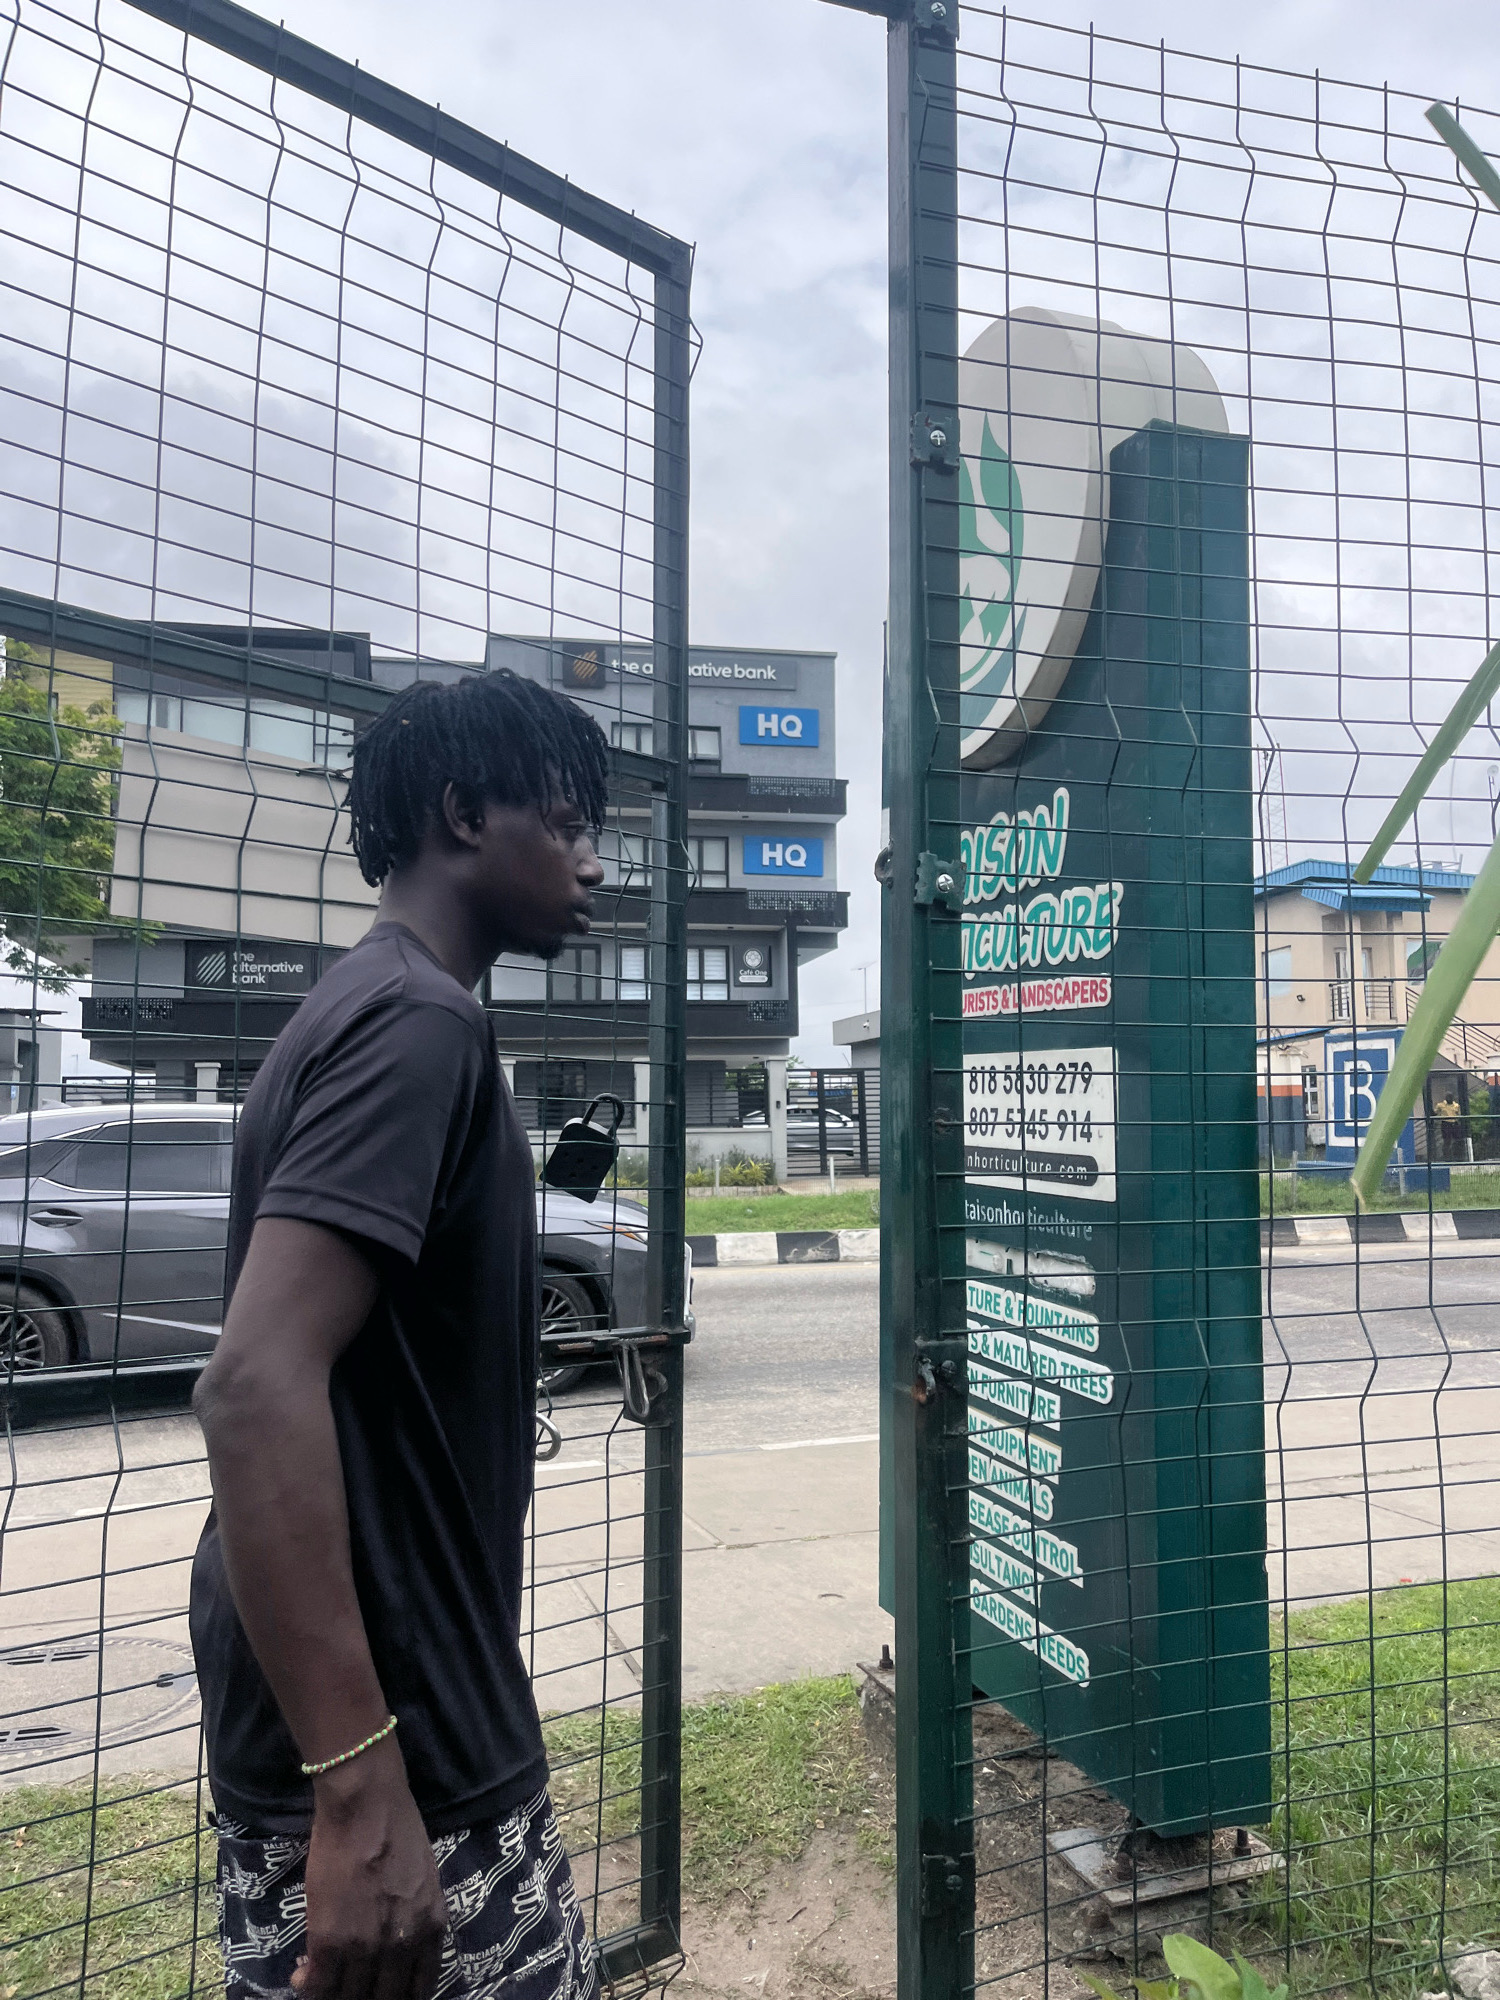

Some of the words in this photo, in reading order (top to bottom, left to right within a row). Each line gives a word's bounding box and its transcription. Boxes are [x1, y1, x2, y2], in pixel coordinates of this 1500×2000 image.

[734, 663, 777, 680] bank
[757, 713, 803, 738] HQ
[762, 842, 807, 868] HQ
[233, 961, 304, 973] alternative
[1001, 987, 1009, 1010] &
[1012, 979, 1108, 1008] LANDSCAPERS
[969, 1066, 998, 1095] 818
[1055, 1061, 1093, 1095] 279
[969, 1107, 999, 1136] 807
[1057, 1109, 1093, 1143] 914
[967, 1285, 1001, 1316] TURE
[1004, 1296, 1014, 1320] &
[1018, 1299, 1095, 1348] FOUNTAINS
[981, 1333, 990, 1357] &
[993, 1337, 1057, 1378] MATURED
[1060, 1361, 1108, 1400] TREES
[981, 1373, 1057, 1421] FURNITURE
[980, 1419, 1058, 1475] EQUIPMENT
[968, 1455, 987, 1481] EN
[991, 1466, 1049, 1514] ANIMALS
[973, 1586, 1032, 1645] GARDENS
[1039, 1631, 1086, 1682] NEEDS
